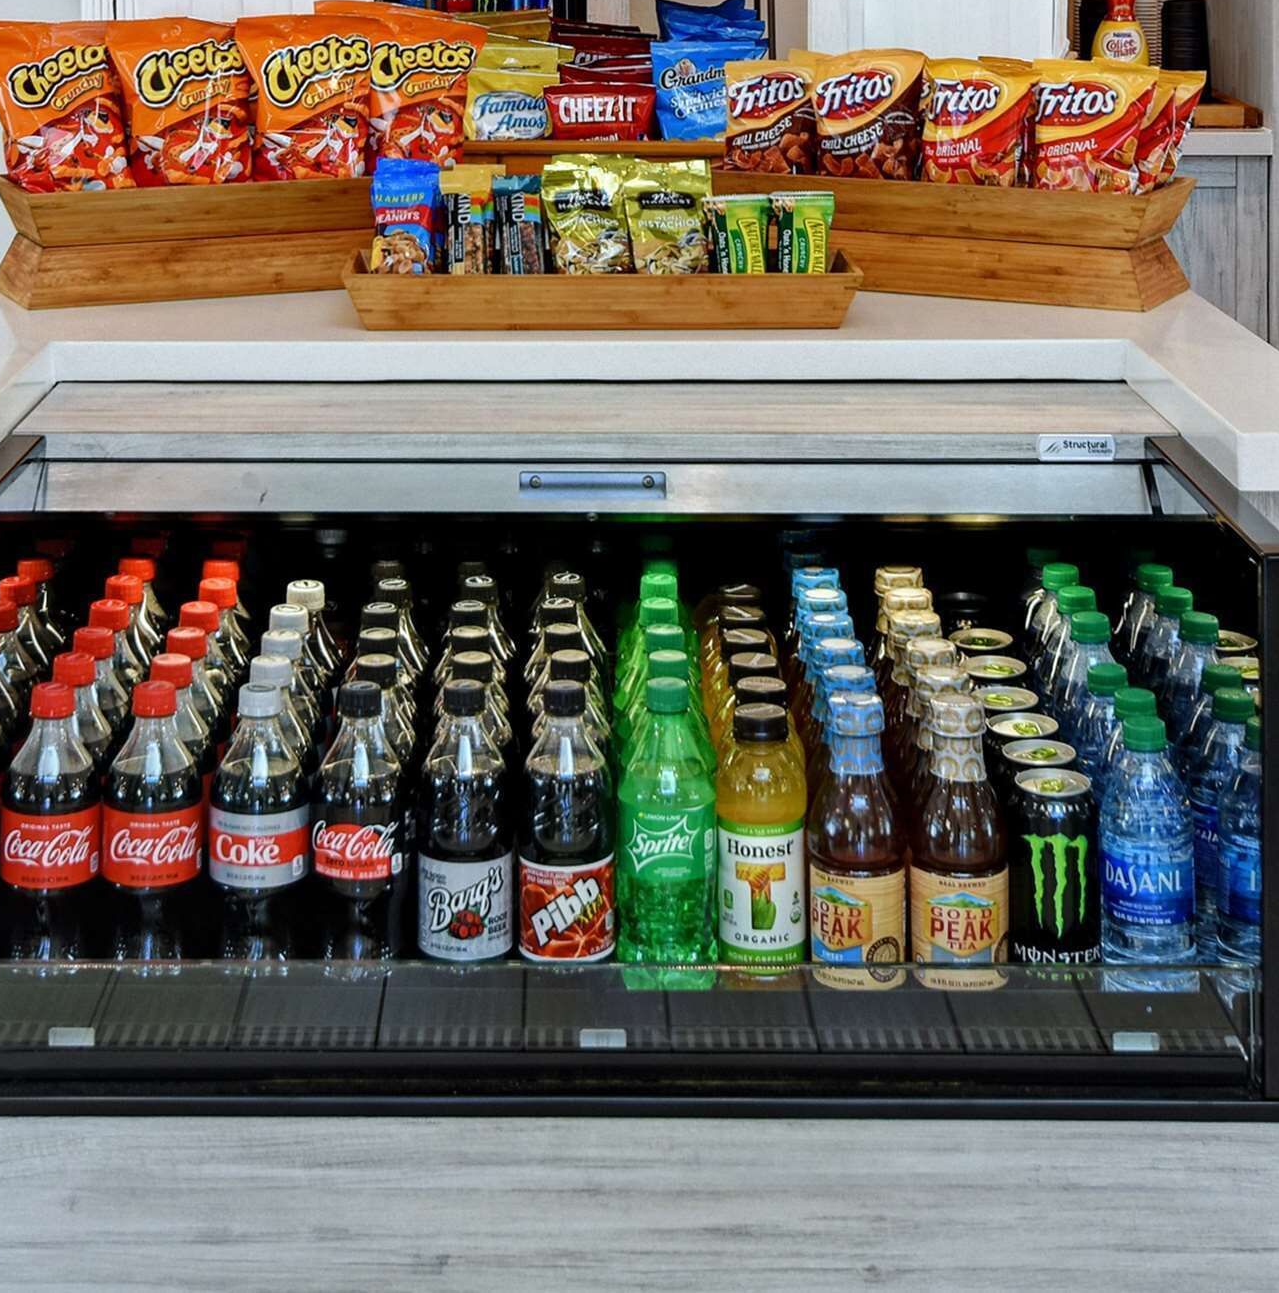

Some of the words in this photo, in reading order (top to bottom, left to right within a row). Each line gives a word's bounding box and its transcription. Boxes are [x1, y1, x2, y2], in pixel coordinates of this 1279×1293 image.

[11, 44, 107, 104] Cheeto
[138, 41, 245, 104] Cheetos
[265, 36, 369, 103] Cheetos
[370, 41, 474, 87] Cheetos
[51, 72, 104, 110] Crunchy
[402, 75, 459, 97] Crunchy
[660, 66, 726, 90] Grandm
[176, 79, 232, 110] Crunchy
[474, 94, 546, 121] Famous
[670, 86, 727, 108] Sandwic
[728, 75, 806, 119] Fritos
[815, 72, 894, 117] Fritos
[929, 78, 1000, 121] Fritos
[1036, 82, 1118, 122] Fritos
[488, 113, 546, 135] Amos
[732, 132, 752, 147] CHILI
[754, 115, 793, 142] CHEESE
[821, 136, 841, 150] CHILI
[843, 121, 884, 149] CHEESE
[935, 139, 982, 157] ORIGINAL
[1046, 138, 1098, 157] ORIGINAL
[556, 214, 620, 228] PISTACHIOS
[638, 217, 701, 229] PISTACHIOS
[718, 231, 727, 248] Oats
[782, 229, 791, 246] Oats
[782, 256, 791, 274] Hone
[1062, 439, 1108, 450] Structural
[4, 825, 93, 868] Coca-Cola
[111, 820, 199, 867] Coca-Cola
[216, 834, 281, 866] Coke
[312, 819, 400, 861] Coca-Cola
[632, 831, 691, 857] Sprite
[727, 838, 792, 858] Honest
[1105, 859, 1182, 897] DASANI
[427, 865, 504, 933] Barq's
[531, 877, 601, 947] Pibb
[488, 911, 508, 924] ROOT
[812, 908, 864, 940] PEAK
[930, 906, 993, 920] GOLD
[488, 922, 507, 934] BEER
[735, 933, 790, 944] ORGANIC
[819, 934, 844, 947] TEA
[930, 918, 993, 941] PEAK
[727, 951, 753, 962] HONEY
[755, 954, 783, 962] GREEN
[785, 952, 798, 961] TEA
[947, 940, 977, 950] TEA
